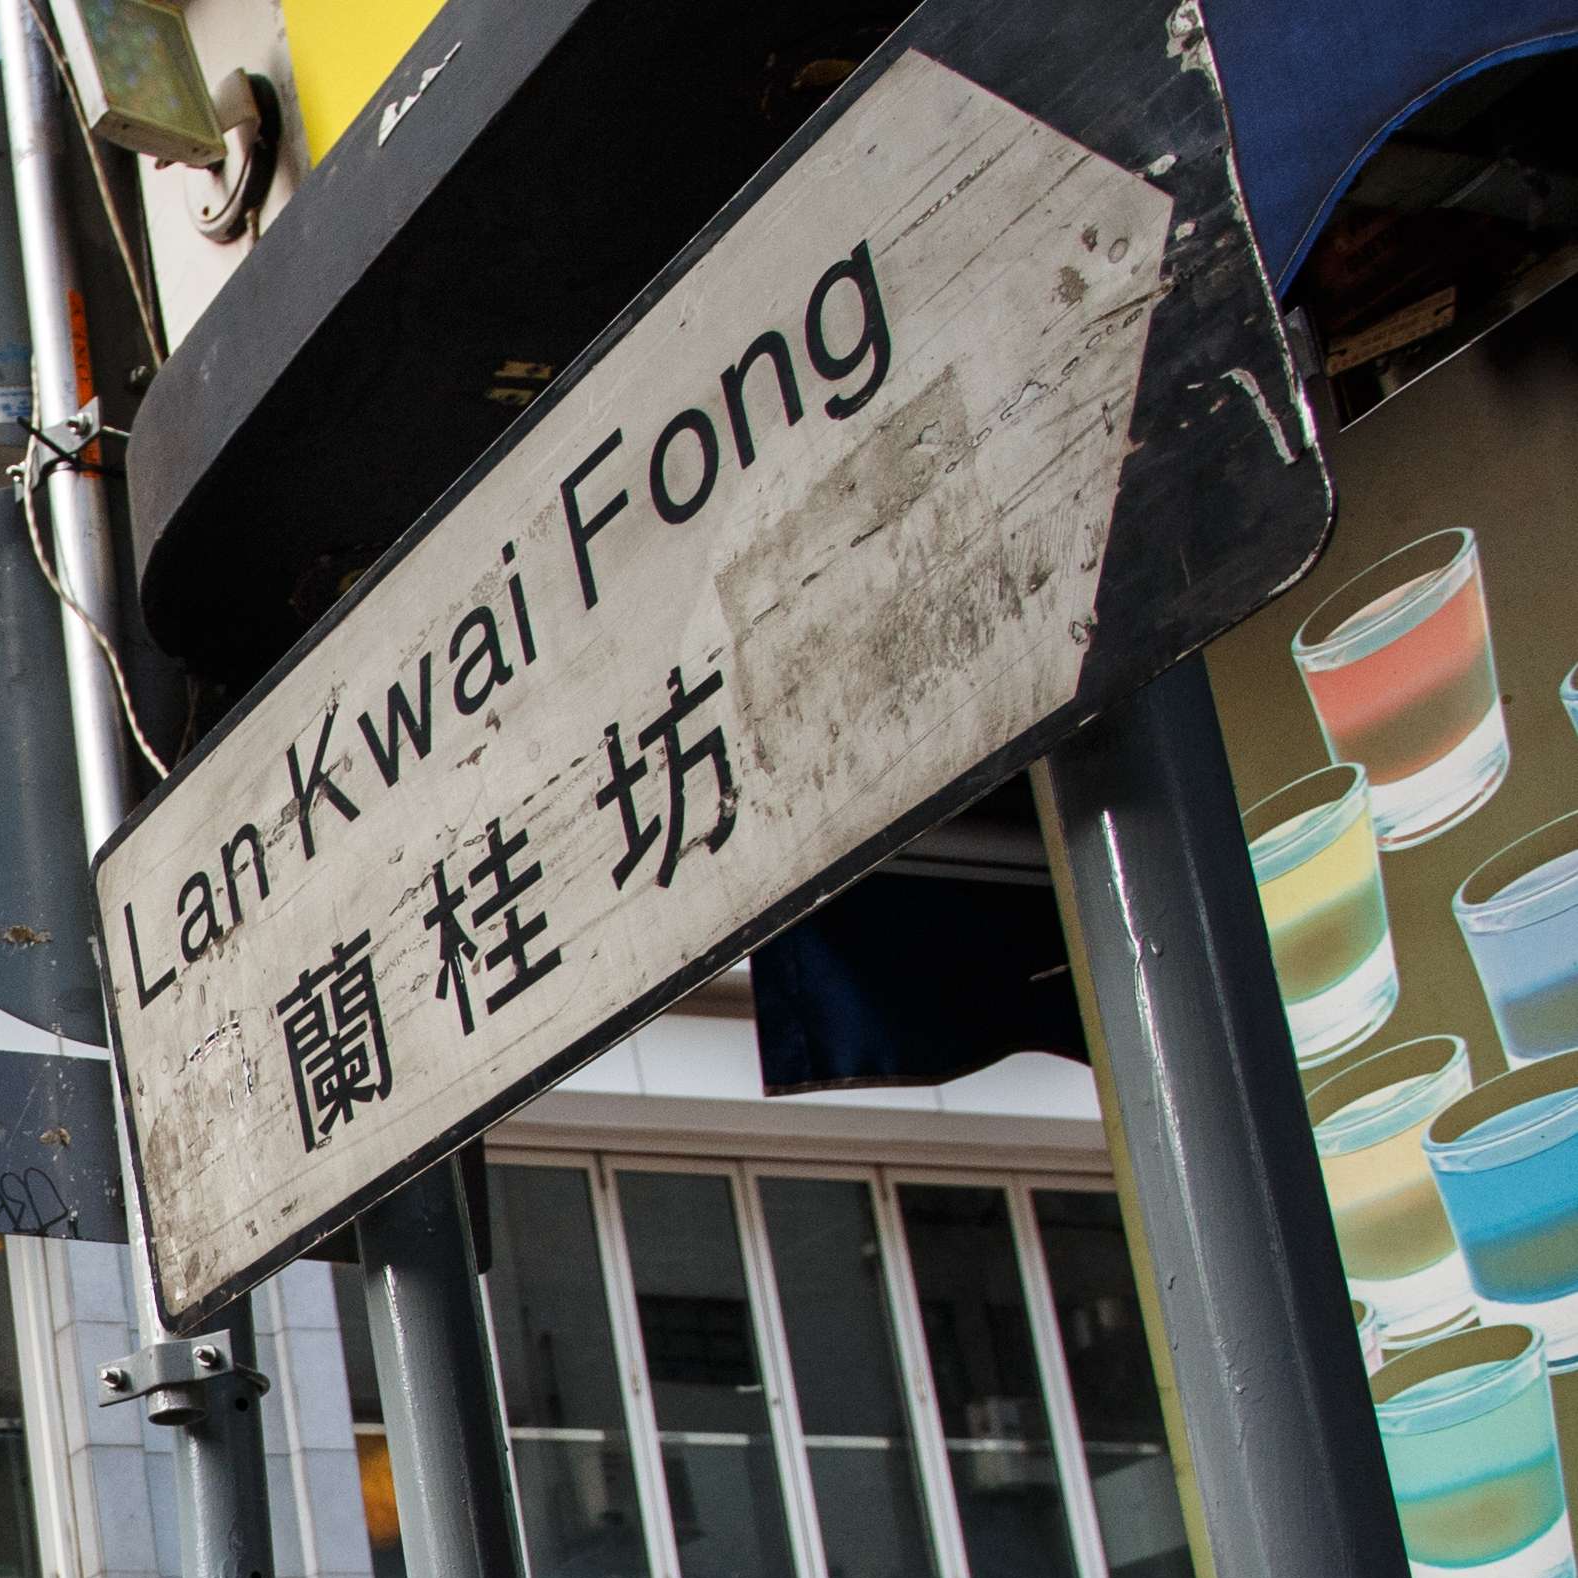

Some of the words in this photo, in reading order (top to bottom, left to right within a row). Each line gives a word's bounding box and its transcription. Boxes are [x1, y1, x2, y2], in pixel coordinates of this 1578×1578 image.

[124, 823, 270, 1009] Lan
[286, 541, 541, 860] Kwai
[560, 239, 893, 609] Fong
[275, 665, 740, 1152] 蘭桂坊
